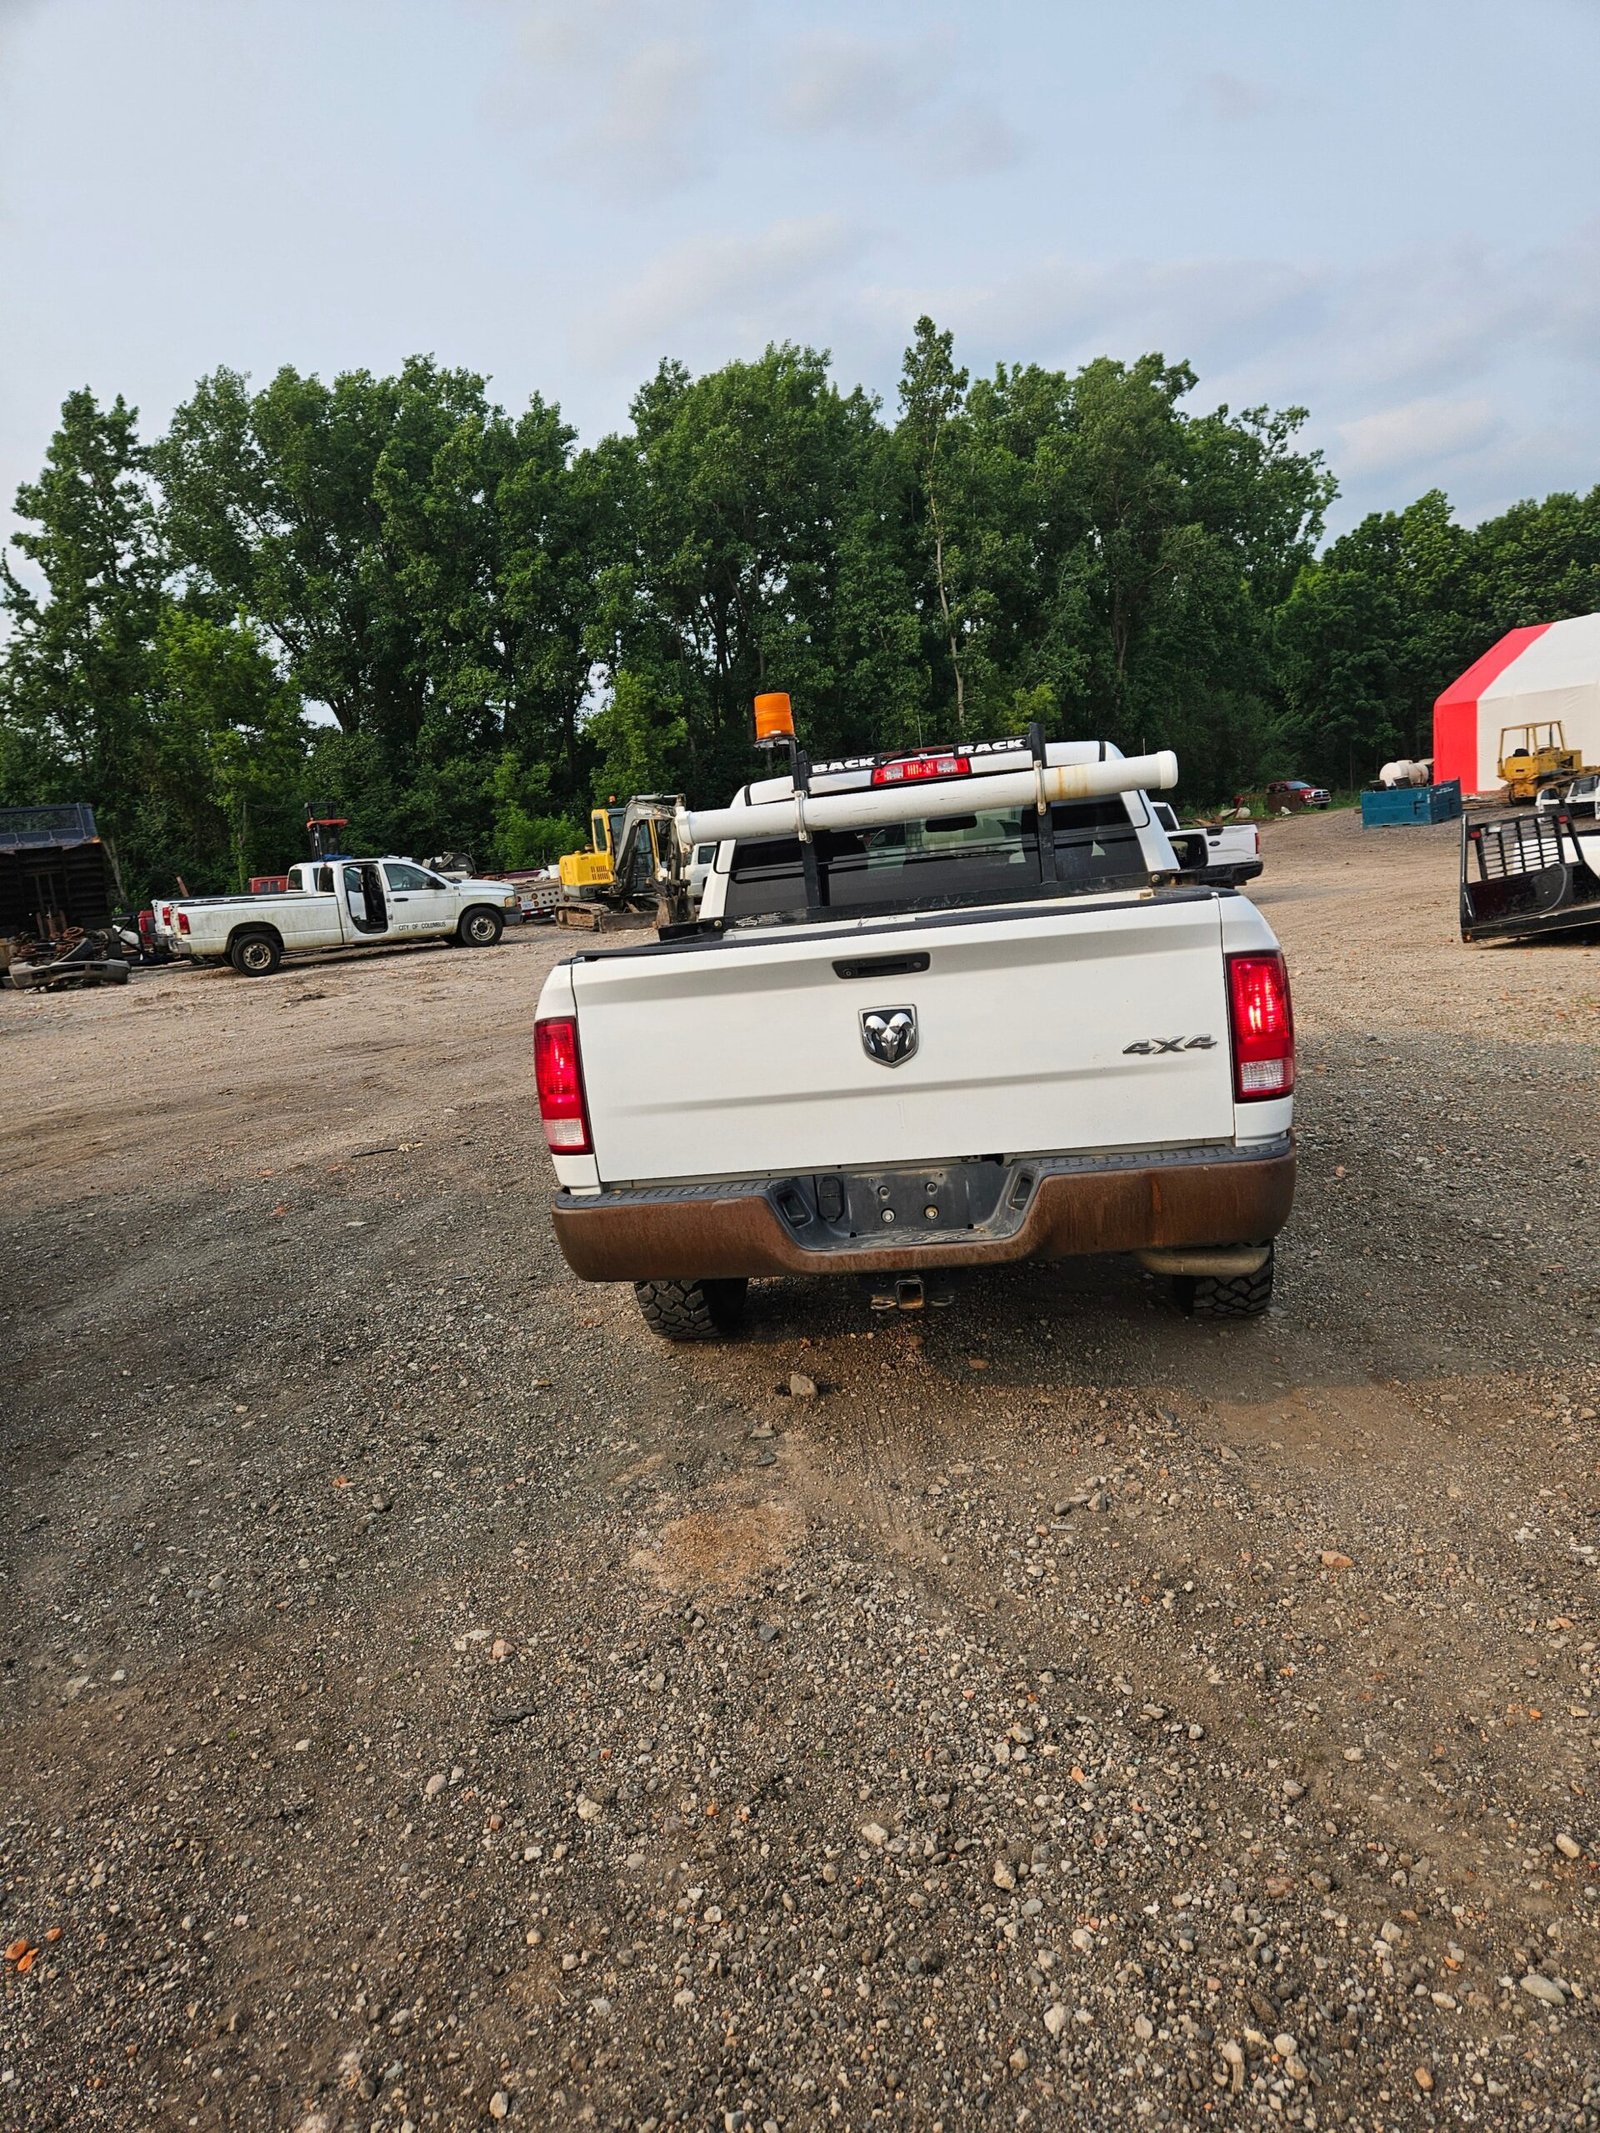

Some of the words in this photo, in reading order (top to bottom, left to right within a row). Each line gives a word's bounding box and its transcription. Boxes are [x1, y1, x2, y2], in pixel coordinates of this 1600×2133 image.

[811, 757, 876, 773] BACK
[958, 738, 1026, 755] RACK
[421, 921, 446, 929] COLUMBUS
